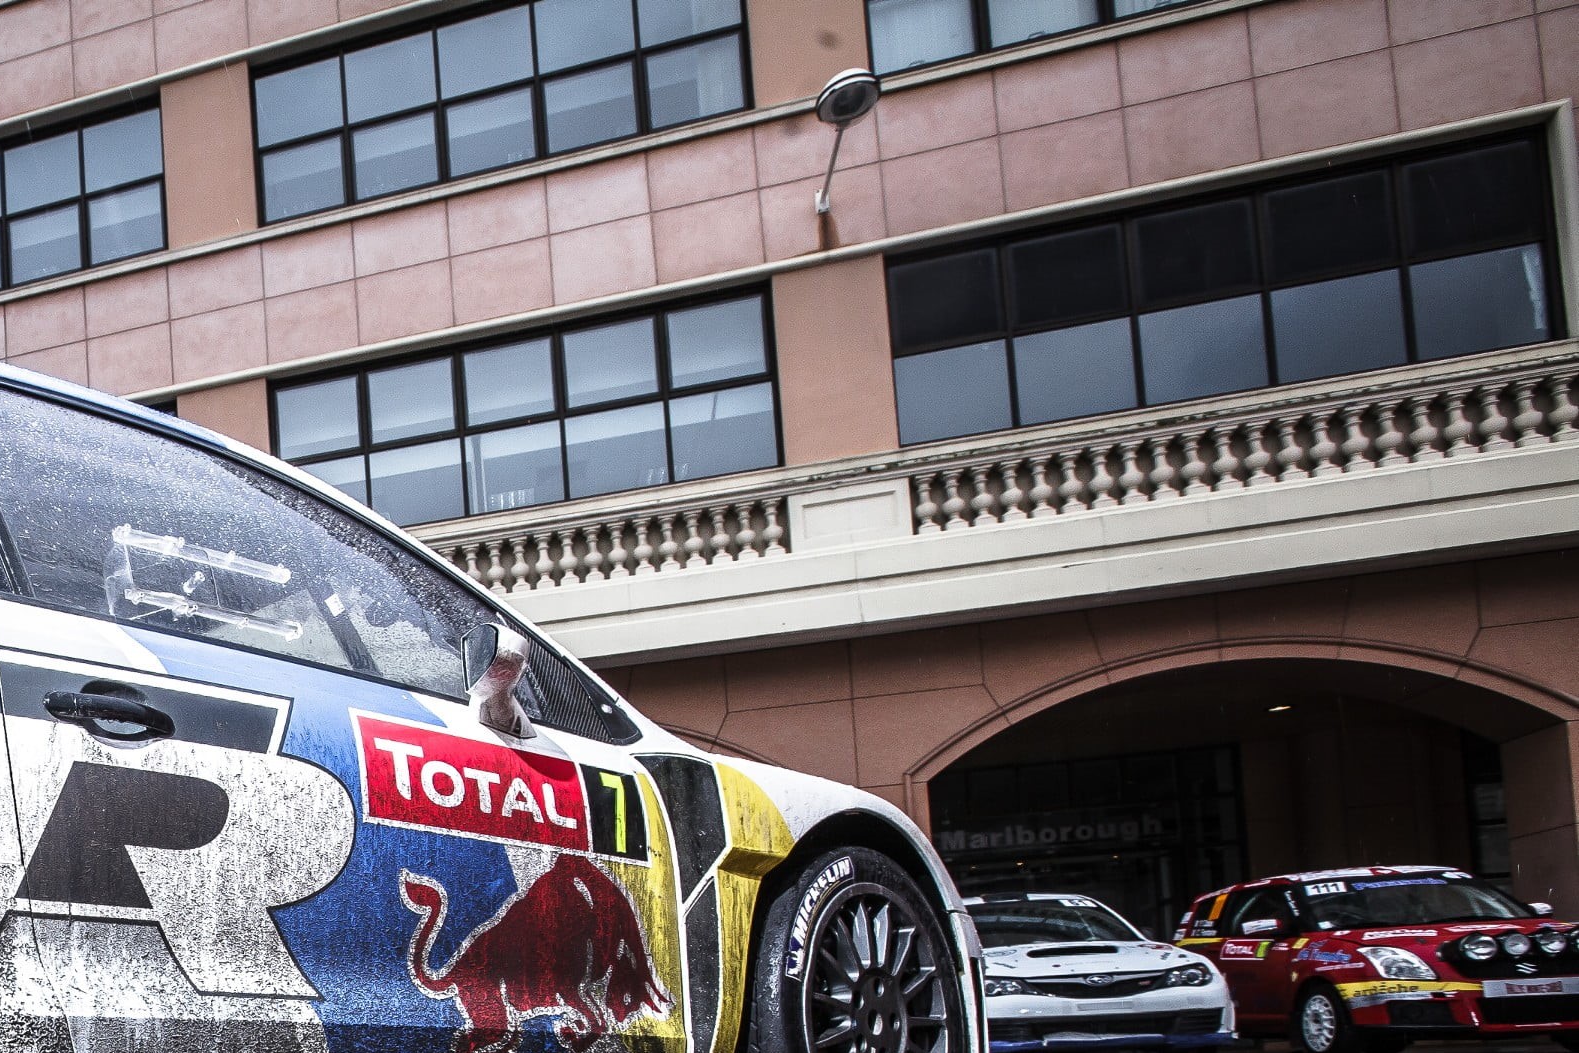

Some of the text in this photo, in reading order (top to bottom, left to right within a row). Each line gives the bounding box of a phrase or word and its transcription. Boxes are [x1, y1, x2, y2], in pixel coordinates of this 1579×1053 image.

[373, 737, 577, 829] TOTAL
[599, 772, 627, 853] 7
[938, 813, 1163, 851] Marlborough
[793, 859, 850, 946] MICHELIN
[1311, 883, 1340, 893] 111
[1225, 943, 1254, 955] TOTAL
